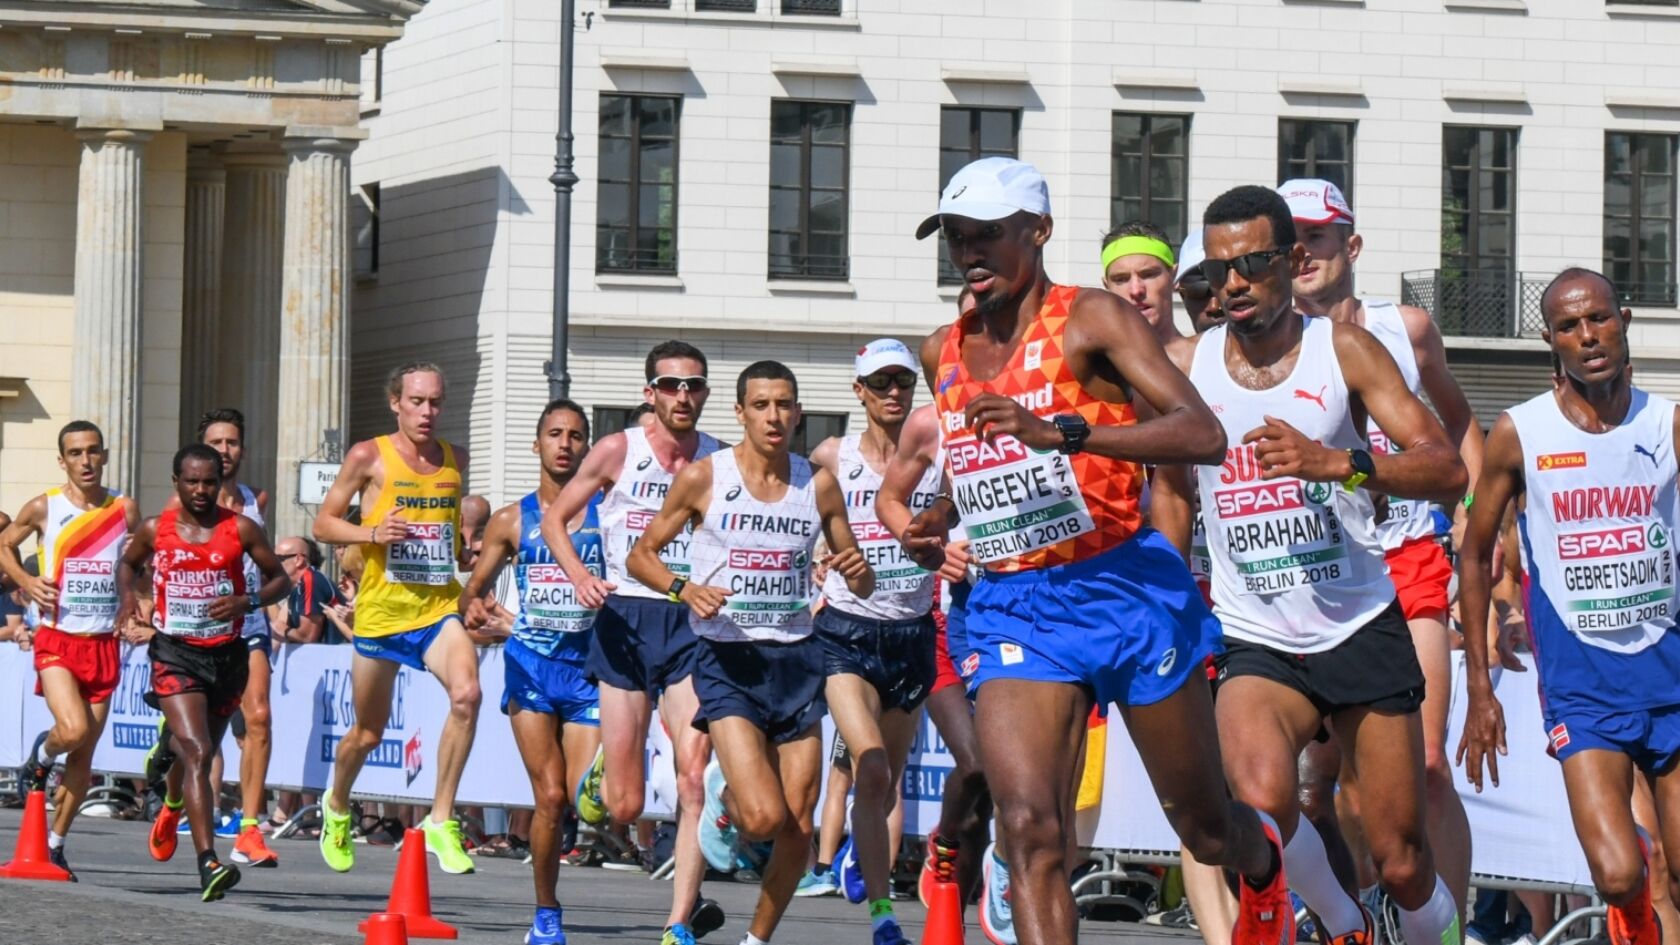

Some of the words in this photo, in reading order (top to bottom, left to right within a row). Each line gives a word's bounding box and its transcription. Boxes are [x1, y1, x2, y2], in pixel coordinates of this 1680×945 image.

[1284, 190, 1319, 199] LSKA
[951, 436, 1024, 472] SPAR
[1553, 456, 1585, 466] EXTRA
[1052, 456, 1074, 498] 273
[957, 466, 1053, 516] NAGEEYE
[1216, 484, 1301, 515] SPAR
[396, 496, 456, 509] SWEDEN
[1388, 505, 1409, 520] 018
[1552, 485, 1656, 523] NORWAY
[405, 525, 440, 538] PAR
[738, 513, 812, 537] FRANCE
[987, 520, 1011, 534] RUN
[1227, 513, 1324, 554] ABRAHAM
[1324, 506, 1341, 544] 285
[626, 535, 690, 558] MATY
[975, 531, 1032, 560] BERLIN
[1034, 517, 1081, 545] 2018
[1559, 530, 1644, 557] SPAR
[391, 543, 446, 561] EKVALL
[536, 543, 599, 564] ITIA
[730, 552, 792, 569] SPAR
[861, 545, 912, 566] EFTA
[65, 561, 111, 573] SPAR
[529, 567, 571, 581] SPA
[1253, 560, 1278, 572] RUN
[1564, 557, 1659, 591] GEBRETSADIK
[1662, 550, 1672, 585] 274
[67, 578, 116, 594] ESPAÑA
[730, 574, 796, 596] CHAHDI
[875, 580, 904, 591] RLIN
[1245, 572, 1295, 592] BERLIN
[1301, 564, 1341, 584] 2018
[168, 585, 216, 598] SPAR
[529, 588, 577, 605] RACH
[1596, 599, 1618, 609] RUN
[533, 617, 569, 629] BERLIN
[731, 611, 773, 624] BERLIN
[1577, 610, 1631, 628] BERLIN
[1635, 603, 1668, 622] 2018
[115, 724, 160, 748] SWITZER
